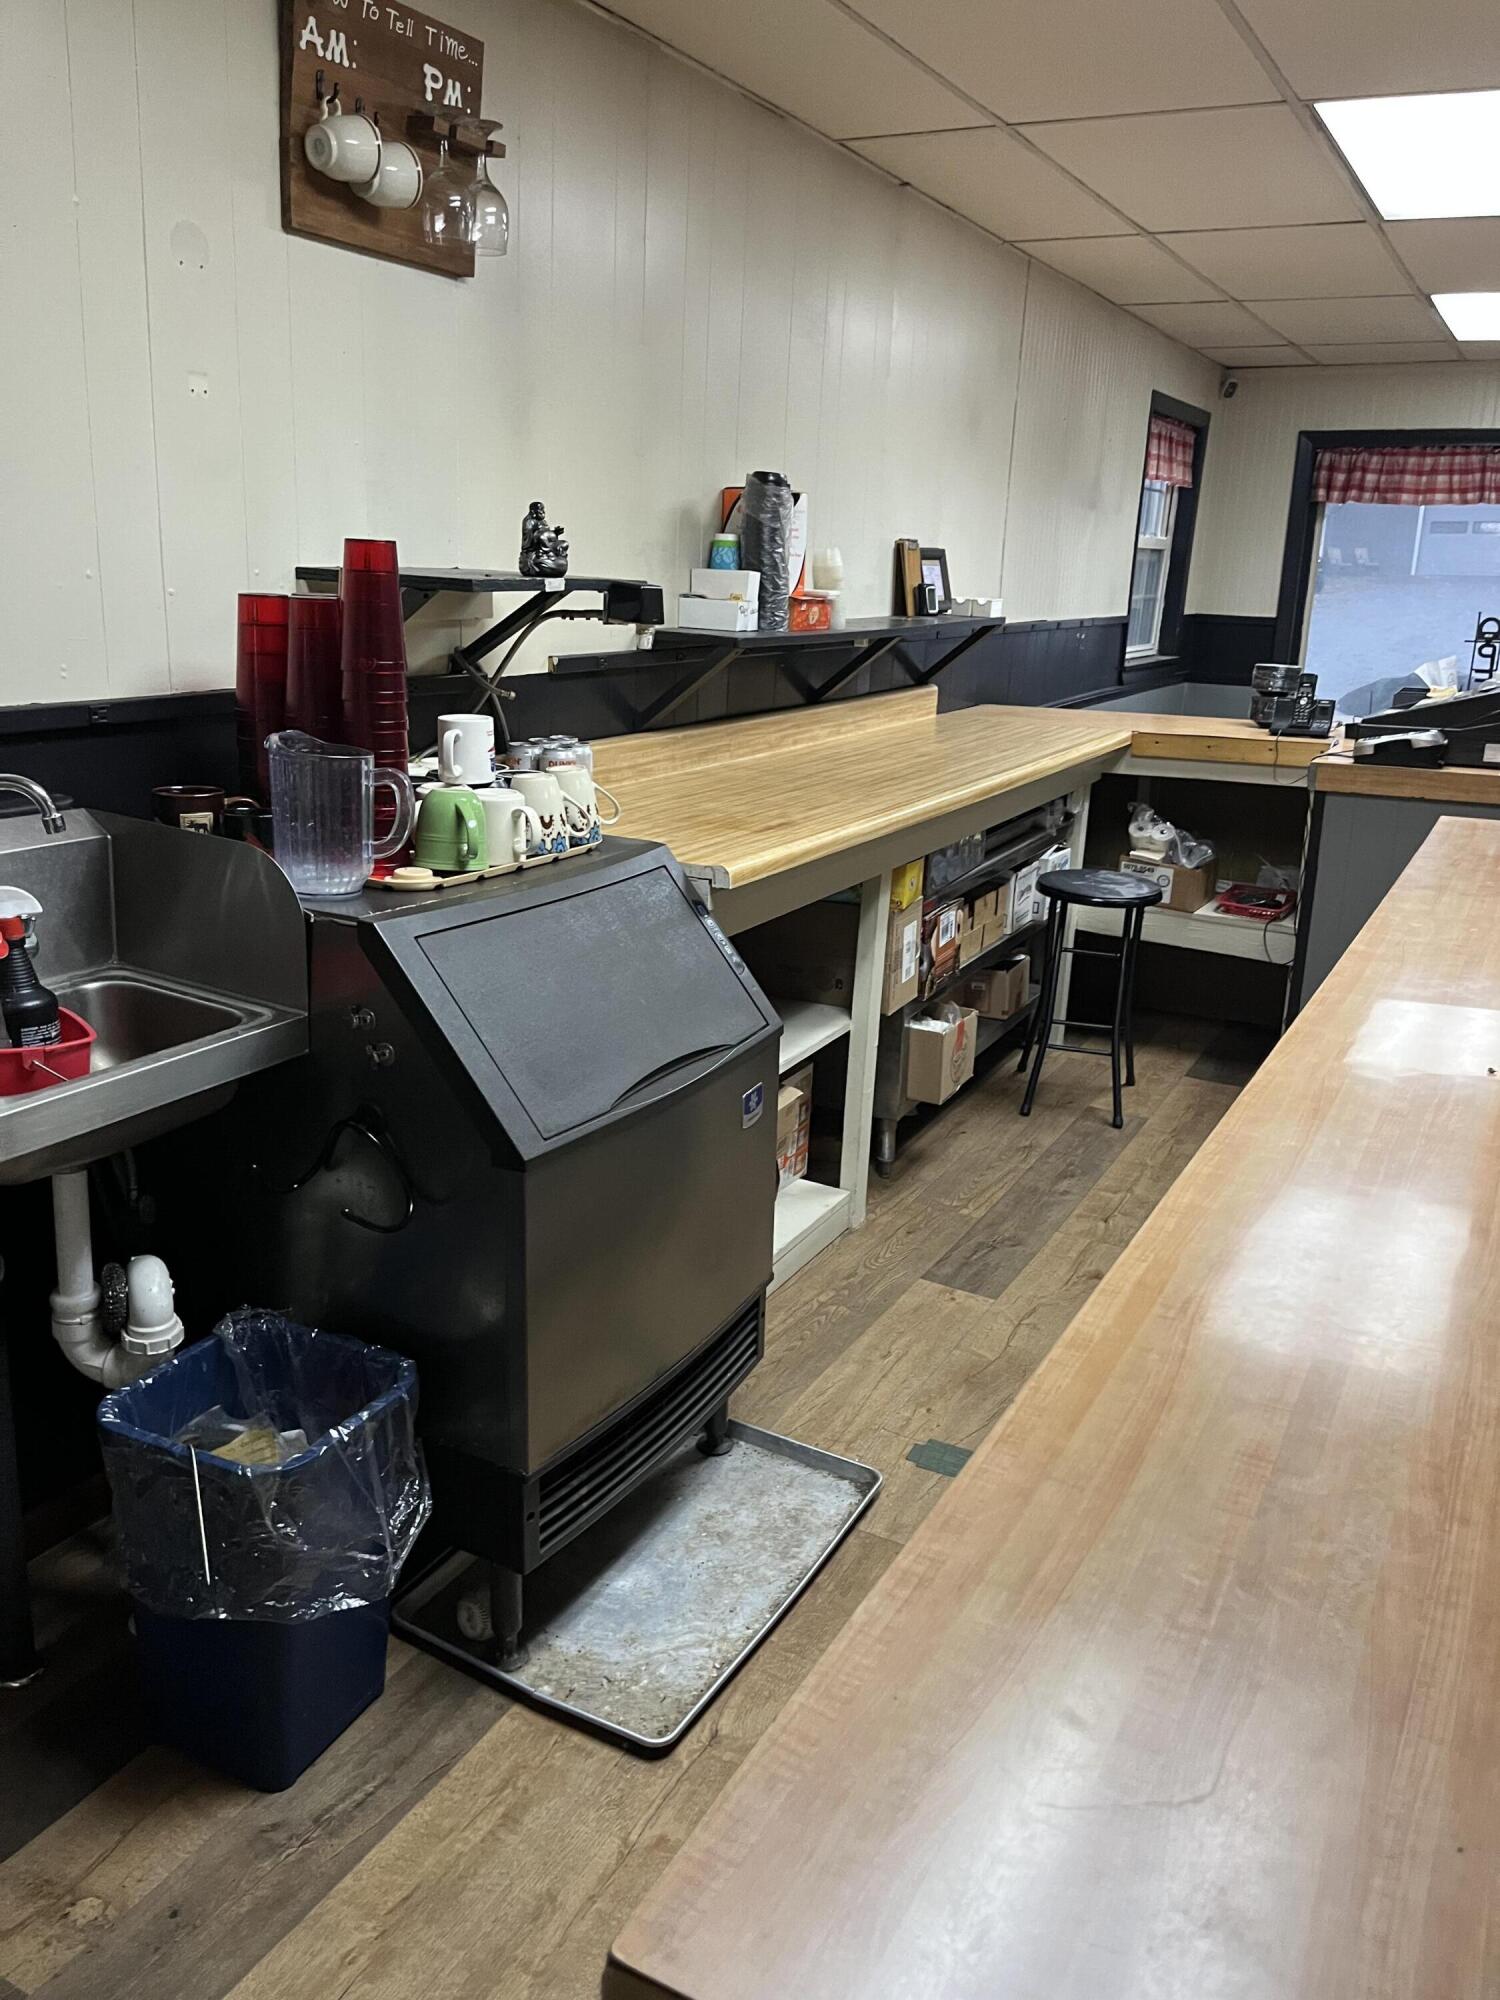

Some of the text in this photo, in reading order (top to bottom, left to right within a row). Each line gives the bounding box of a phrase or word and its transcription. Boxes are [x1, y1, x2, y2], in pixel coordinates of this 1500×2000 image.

[299, 16, 358, 68] AM:
[385, 8, 414, 37] Tell
[423, 63, 472, 114] PM:
